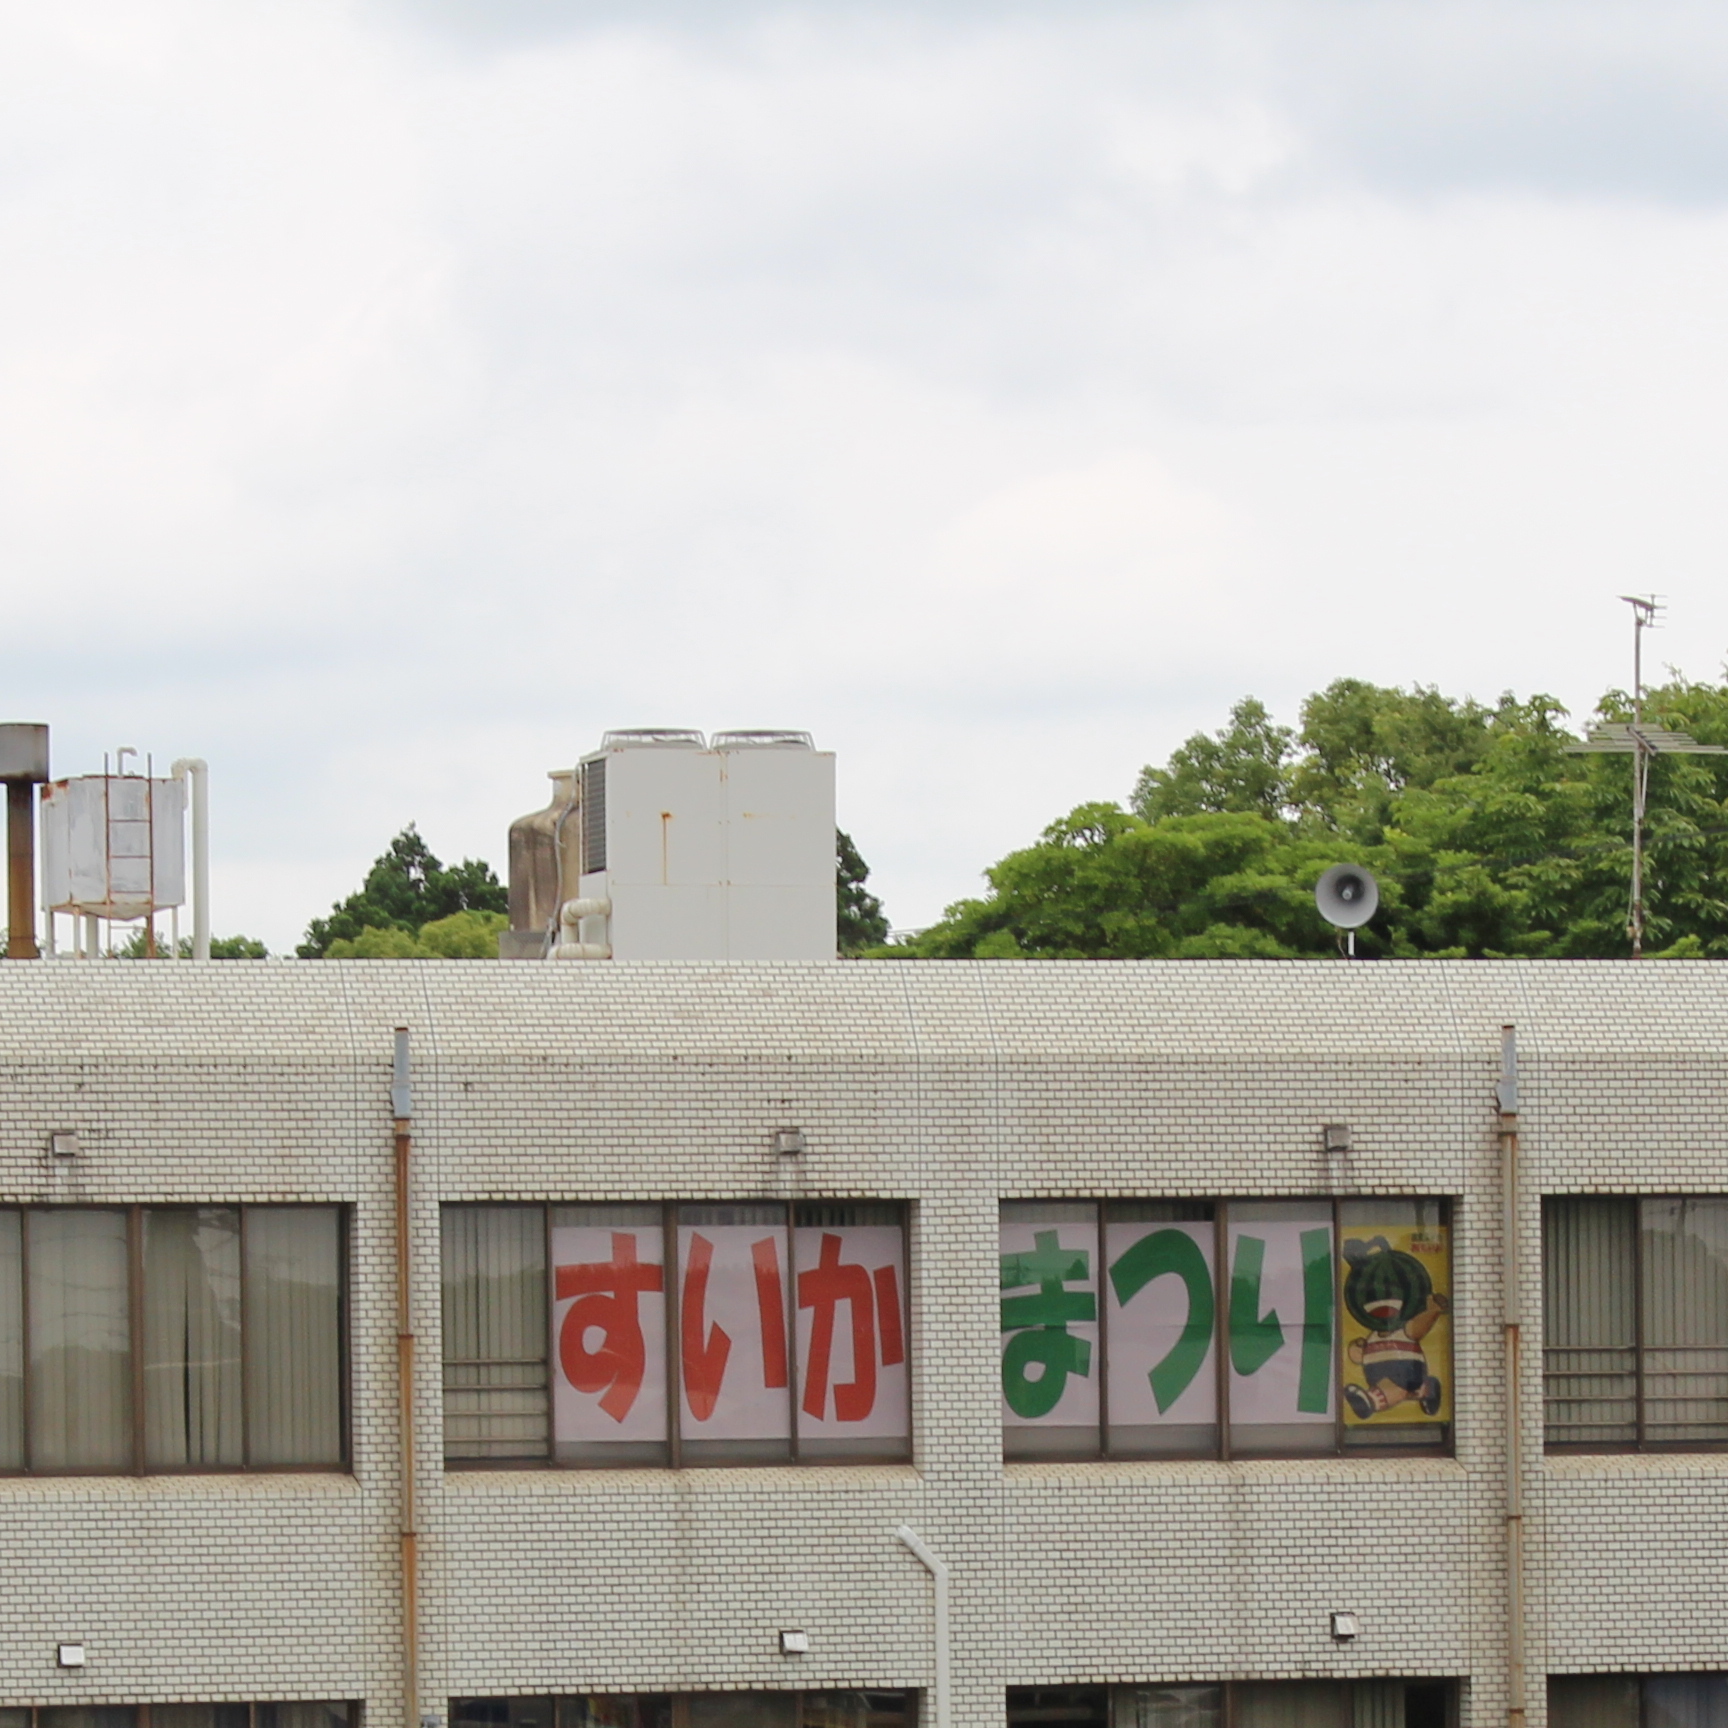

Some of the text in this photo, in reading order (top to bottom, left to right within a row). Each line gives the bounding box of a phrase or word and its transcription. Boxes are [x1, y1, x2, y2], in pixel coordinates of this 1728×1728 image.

[555, 1228, 1334, 1424] すいか まつり
